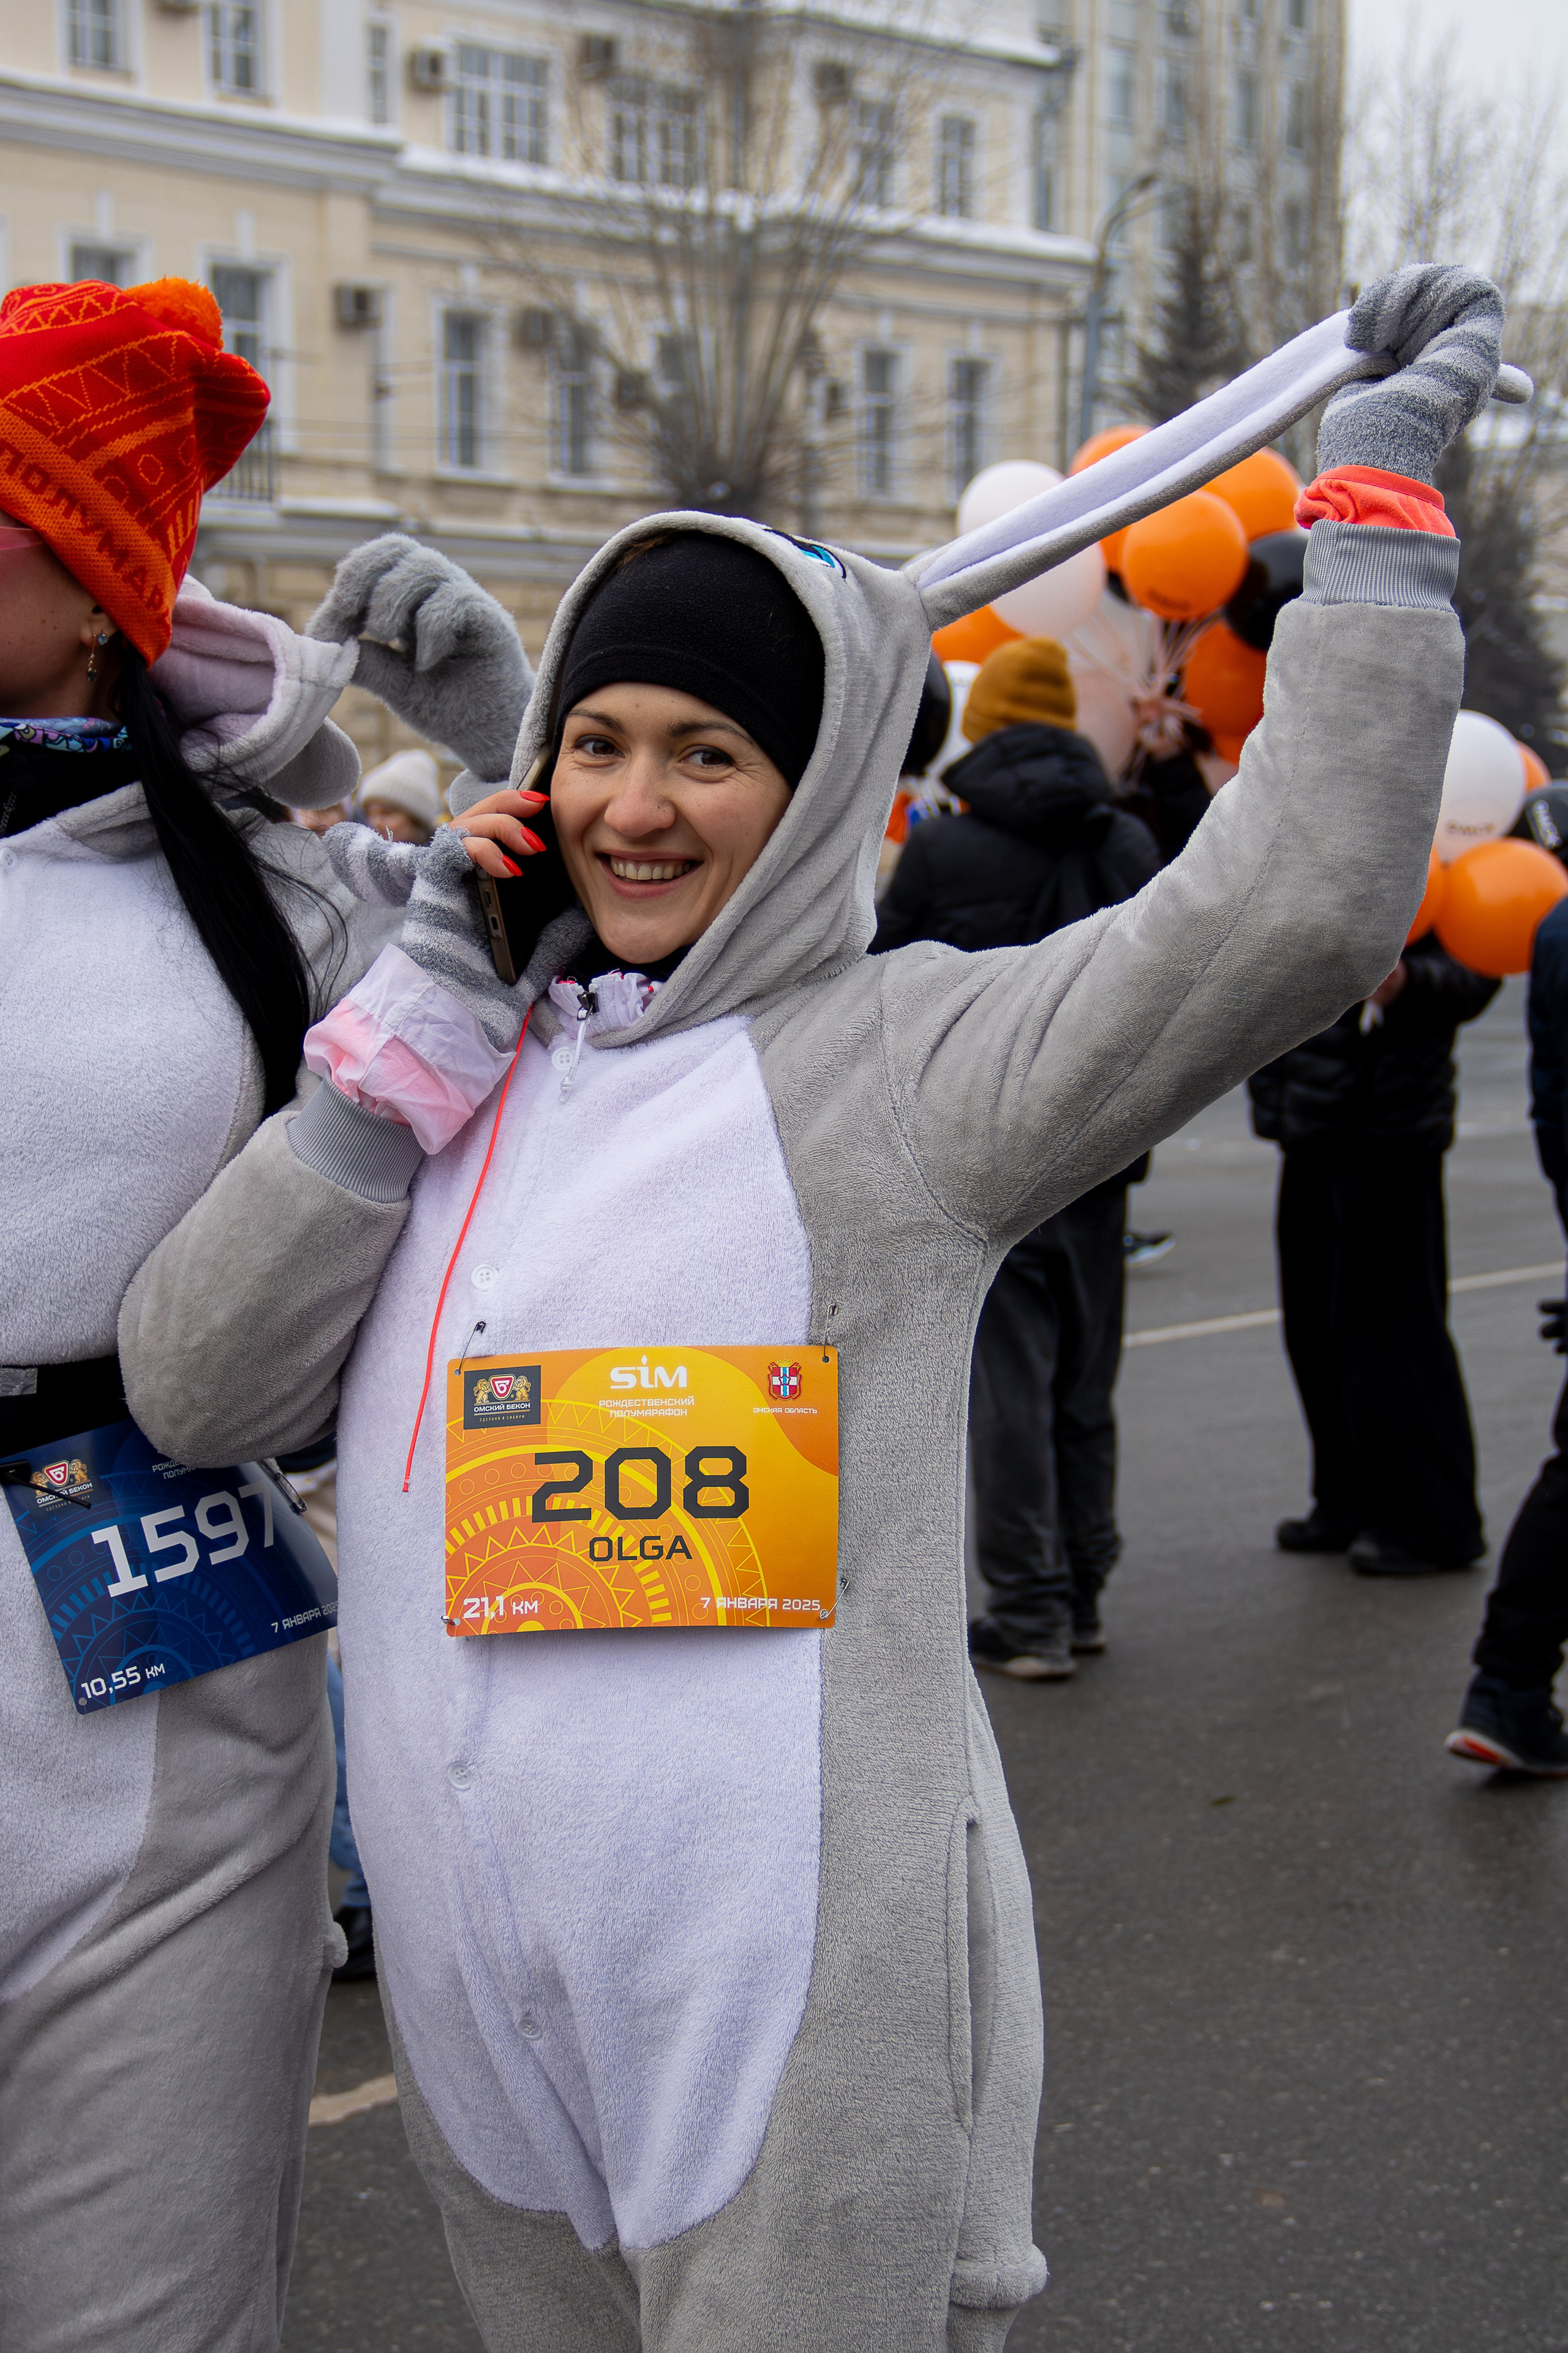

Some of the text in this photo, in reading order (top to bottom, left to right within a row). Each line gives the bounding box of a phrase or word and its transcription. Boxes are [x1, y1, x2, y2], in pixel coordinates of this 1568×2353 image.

[473, 1403, 505, 1412] ОМСКИЙ
[598, 1396, 695, 1408] РОЖДЕСТВЕНСКИЙ
[610, 1408, 687, 1418] ПОЛУМАРАФОН
[37, 1489, 68, 1504] ОМСКЙ
[69, 1482, 92, 1494] БЕКОН
[532, 1446, 749, 1523] 208
[91, 1481, 274, 1598] 1597
[589, 1535, 693, 1562] OLGA
[464, 1595, 503, 1620] 21,1
[701, 1597, 820, 1611] 7 ЯНВАРЯ 2025
[271, 1622, 278, 1633] 7
[282, 1607, 322, 1630] ЯНВАРЯ
[81, 1666, 141, 1699] 10,55
